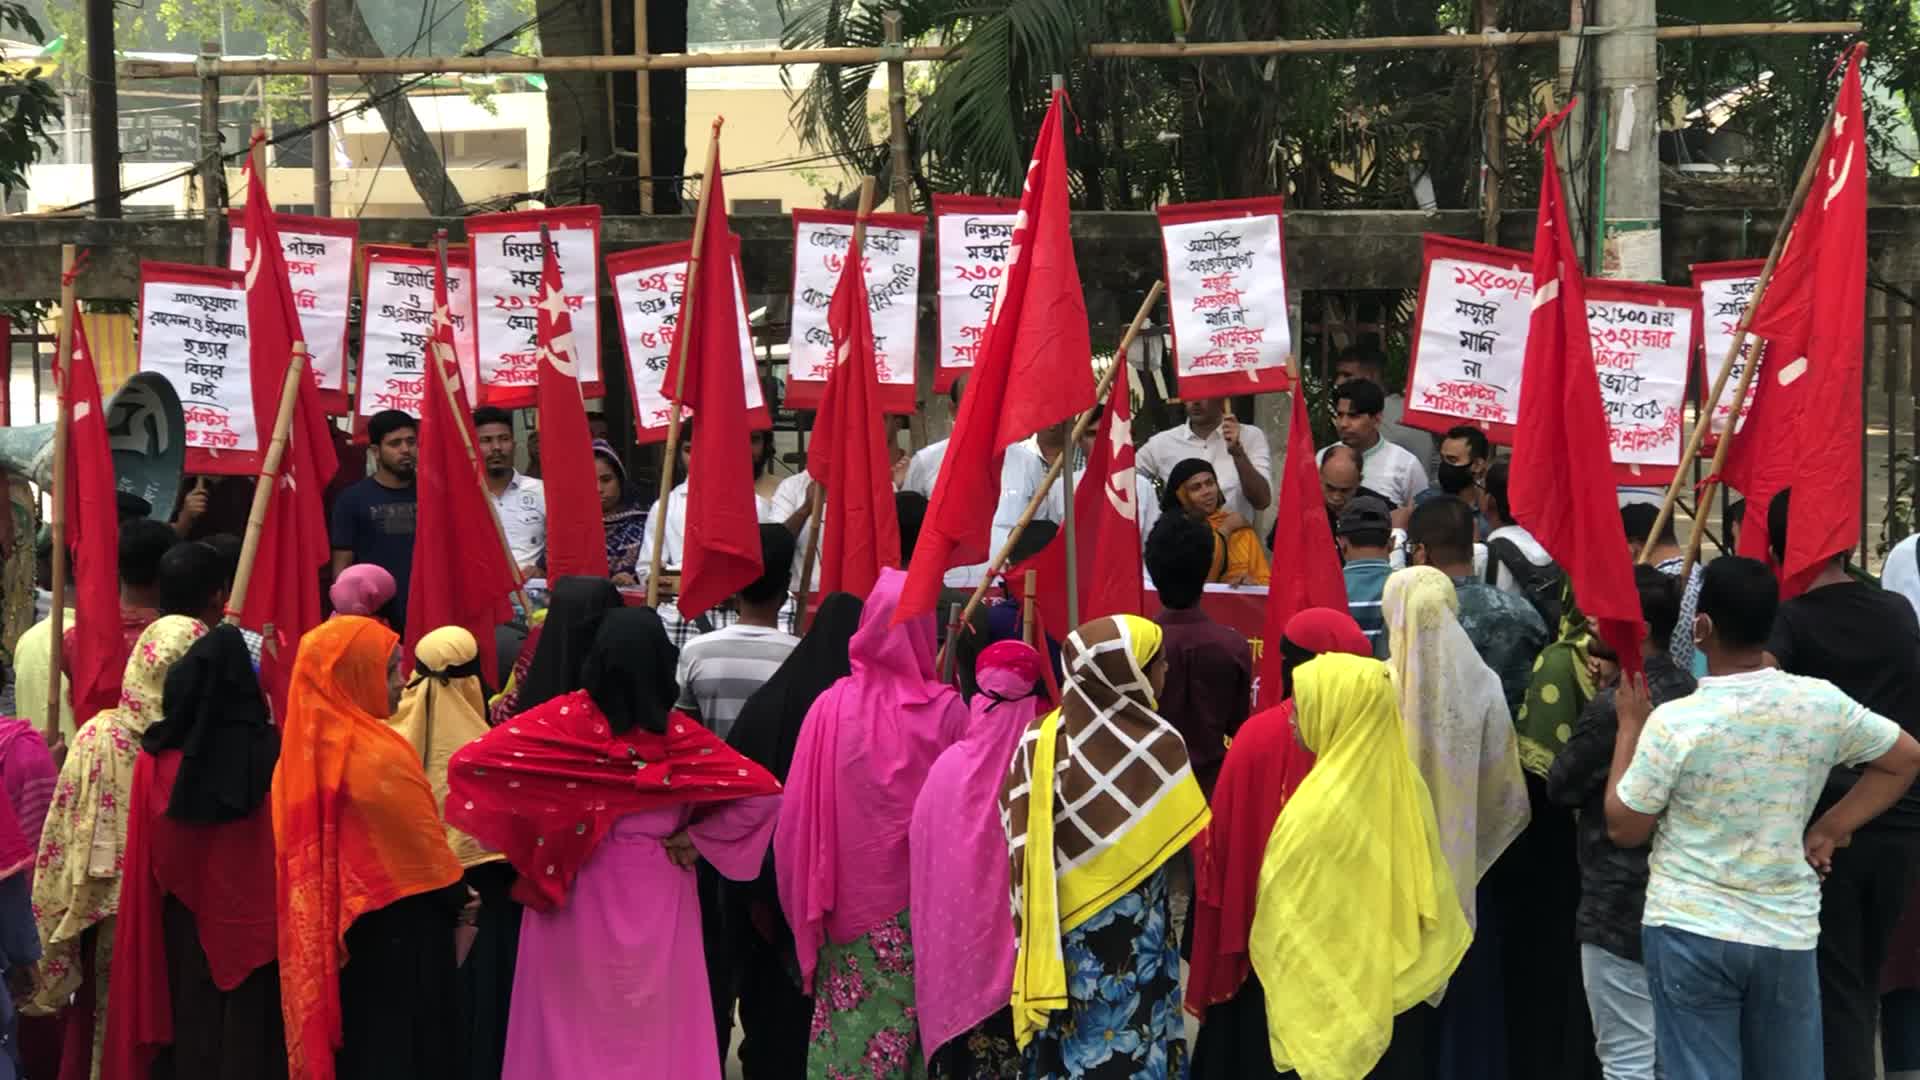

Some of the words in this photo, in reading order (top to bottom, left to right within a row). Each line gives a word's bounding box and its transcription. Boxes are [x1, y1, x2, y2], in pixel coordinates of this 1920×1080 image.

[1204, 306, 1231, 326] মানি
[1232, 307, 1249, 325] না
[1456, 299, 1500, 326] মজুরি
[184, 338, 228, 359] হত্যার
[1460, 331, 1500, 355] মানি
[185, 358, 226, 380] বিচার
[386, 351, 422, 369] মানি
[1463, 359, 1482, 379] না
[190, 379, 218, 400] চাই
[1416, 390, 1471, 415] শ্রমিক
